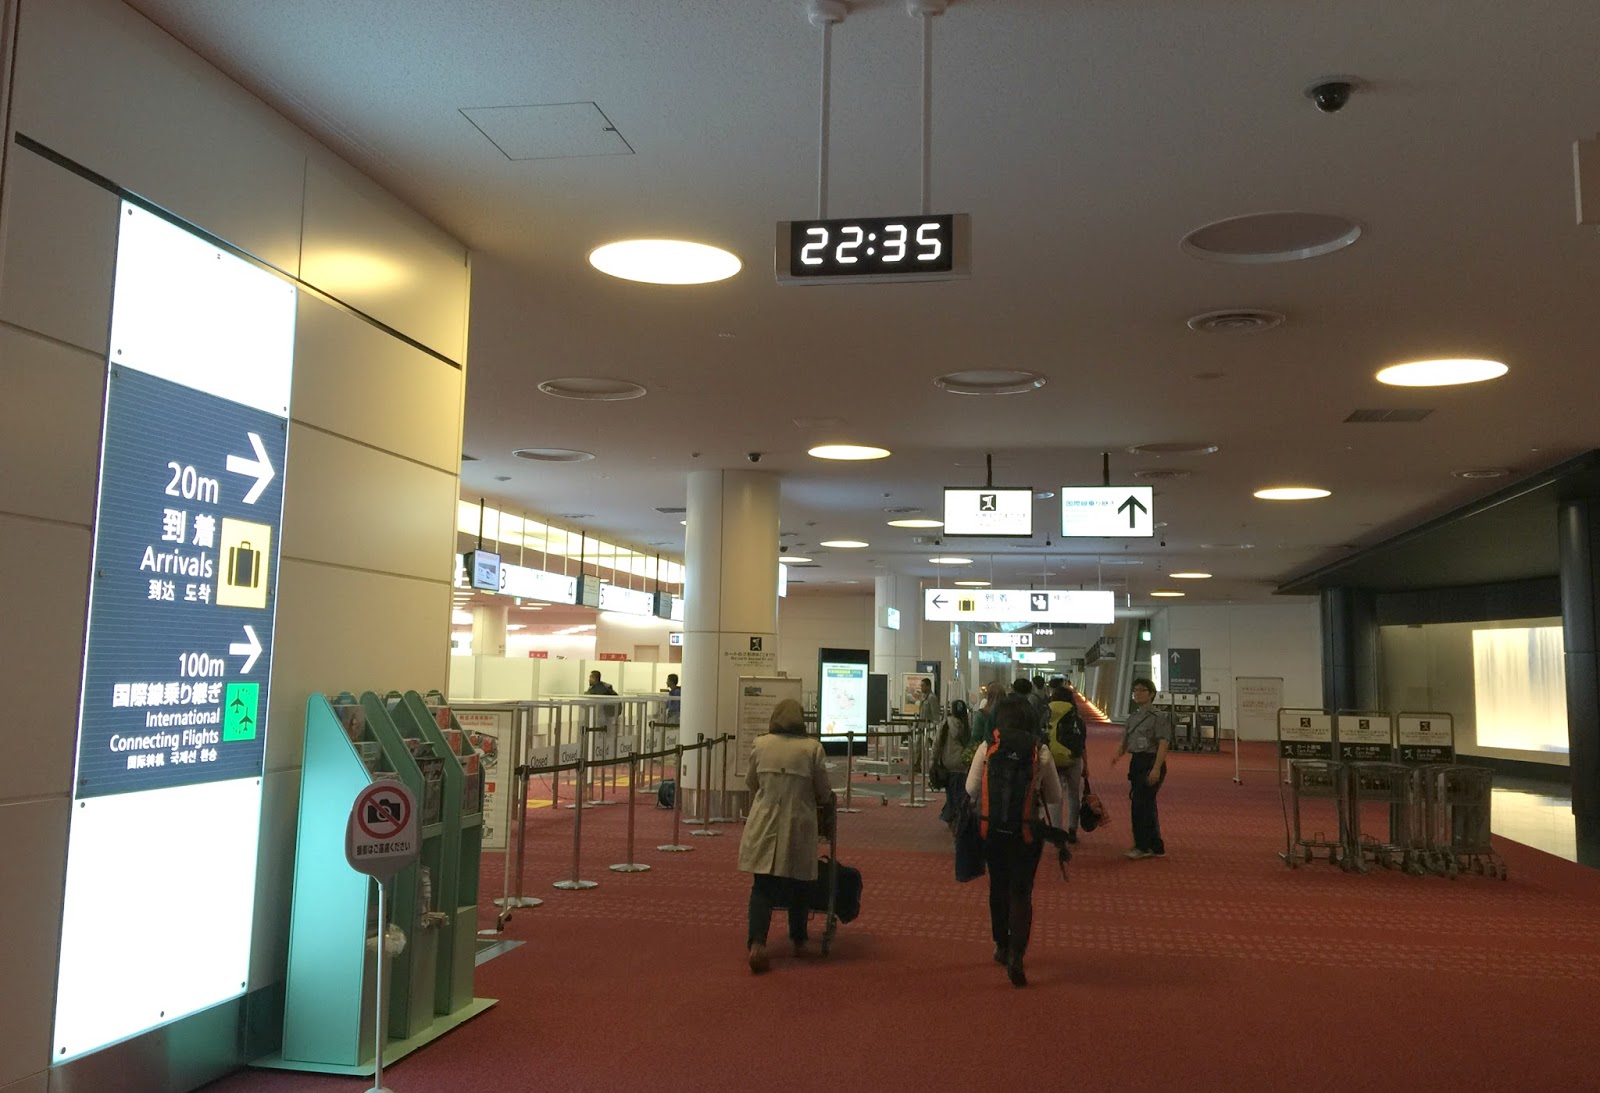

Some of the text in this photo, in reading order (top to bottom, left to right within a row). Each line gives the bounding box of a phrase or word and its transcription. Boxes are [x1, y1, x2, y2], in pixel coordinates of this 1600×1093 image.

[801, 223, 941, 265] 22:35
[165, 461, 219, 504] 20m
[161, 508, 216, 548] 到着
[140, 545, 213, 578] Arrivals
[500, 568, 507, 589] 3
[568, 581, 573, 599] 4
[148, 579, 211, 604] 到达 도착
[600, 587, 605, 605] 5
[178, 652, 224, 677] 100m
[112, 681, 222, 708] 国際線乗り継ぎ
[145, 707, 220, 727] International
[109, 730, 219, 752] Connecting Flights
[530, 753, 548, 768] Closed
[562, 749, 577, 763] Closed
